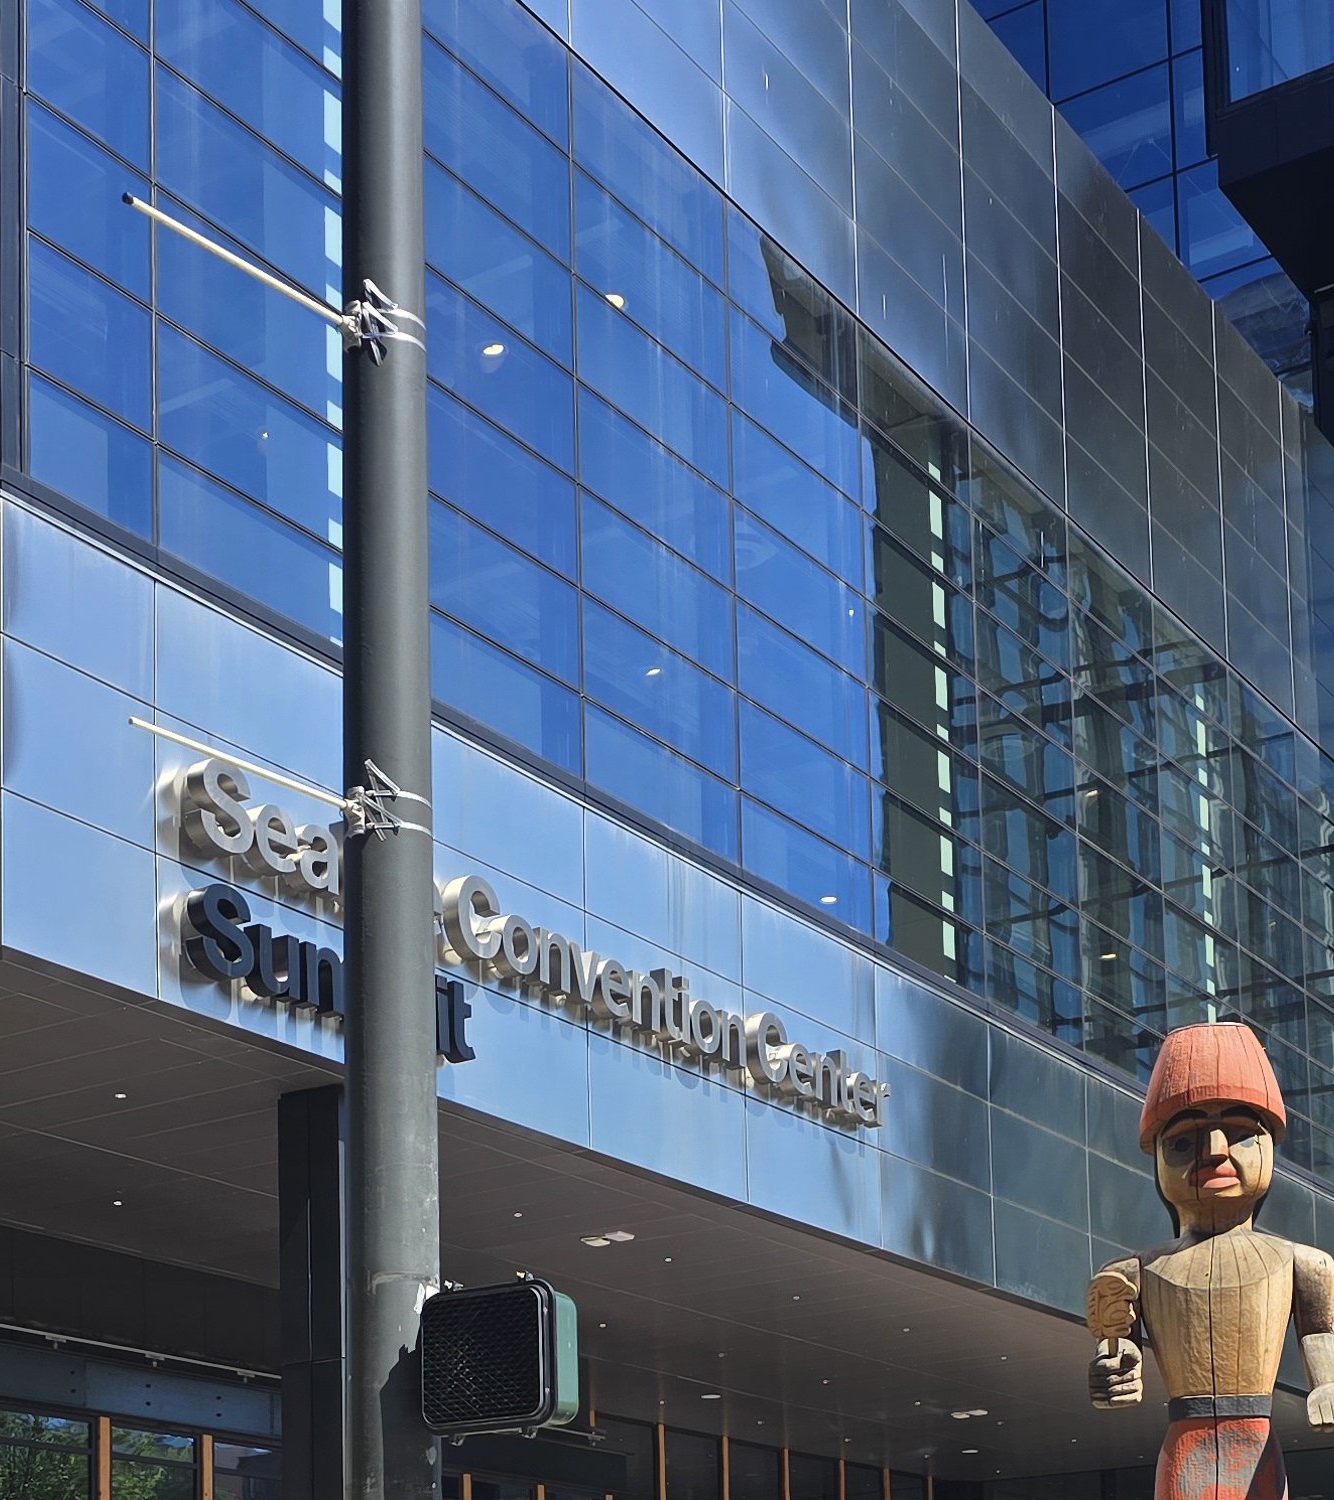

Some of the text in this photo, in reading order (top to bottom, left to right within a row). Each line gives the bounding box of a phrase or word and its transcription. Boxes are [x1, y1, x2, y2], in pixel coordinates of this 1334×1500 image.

[184, 883, 477, 1064] Sumit
[443, 874, 892, 1128] Convention Center
